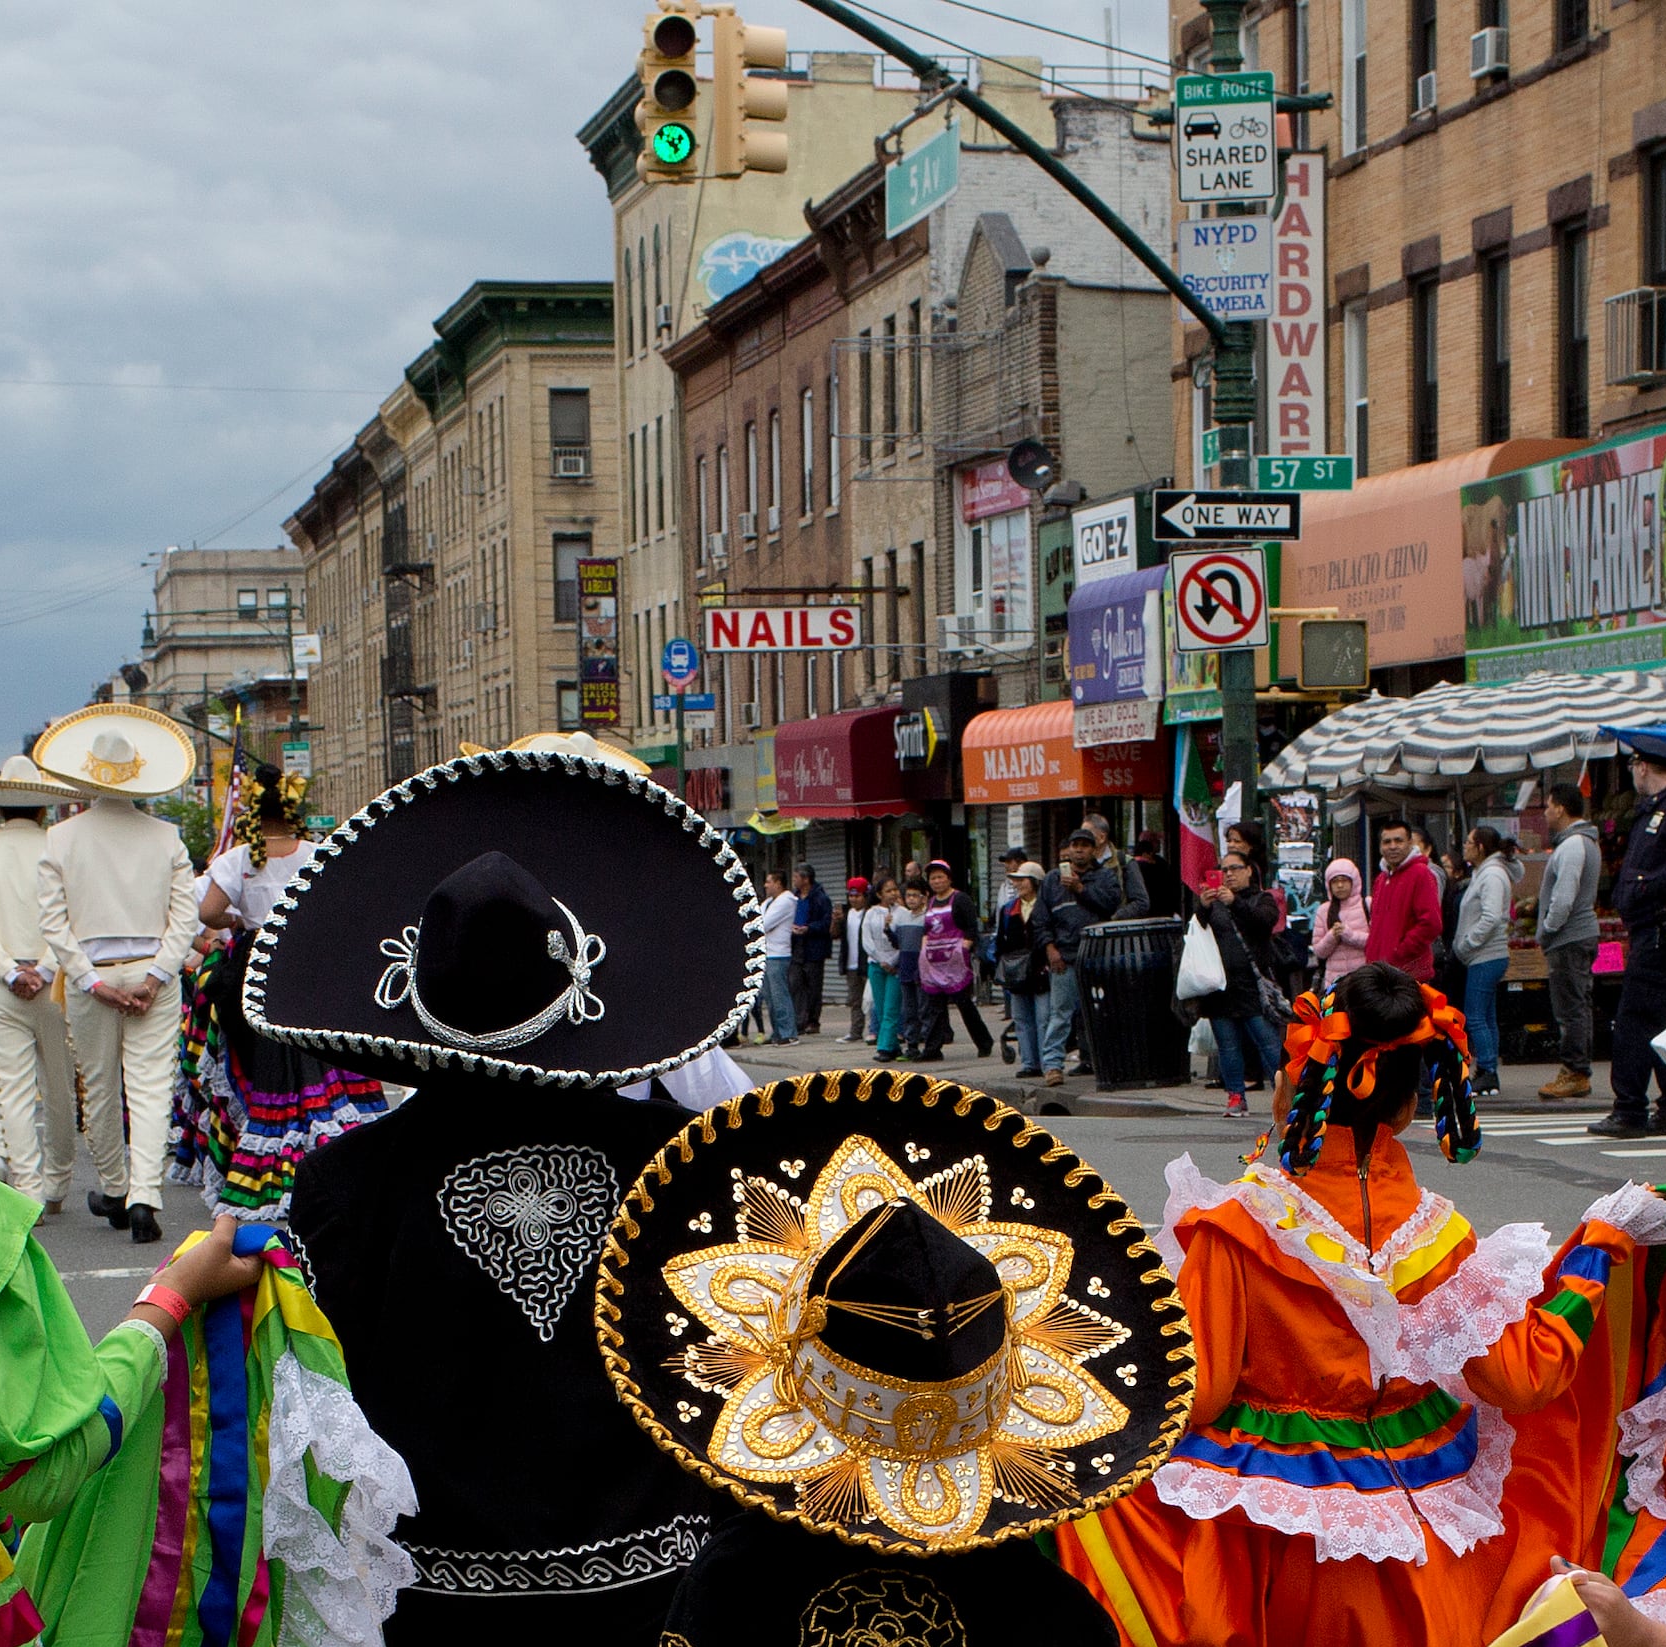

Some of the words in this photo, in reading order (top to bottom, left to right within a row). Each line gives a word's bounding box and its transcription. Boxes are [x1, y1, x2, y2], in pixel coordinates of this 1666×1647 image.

[1184, 83, 1214, 99] BIKE
[1221, 80, 1266, 97] ROUTE
[1186, 145, 1267, 167] SHARED
[910, 164, 919, 206] 5
[1200, 170, 1254, 191] LANE
[1193, 225, 1258, 247] NYPD
[1195, 294, 1266, 312] AMERA
[1271, 460, 1301, 488] 57
[1312, 460, 1337, 479] ST
[1181, 506, 1225, 525] ONE
[1237, 506, 1281, 525] WAY
[1328, 552, 1380, 592] PALACIO
[1385, 541, 1429, 580] CHINO
[711, 608, 855, 648] NAILS
[583, 682, 616, 691] UNISEX
[596, 698, 617, 707] SPA
[1097, 706, 1113, 724] BUY
[1116, 704, 1139, 721] GOLD
[894, 711, 925, 771] Sprint
[983, 744, 1046, 780] MAAPIS
[1093, 744, 1142, 762] SAVE
